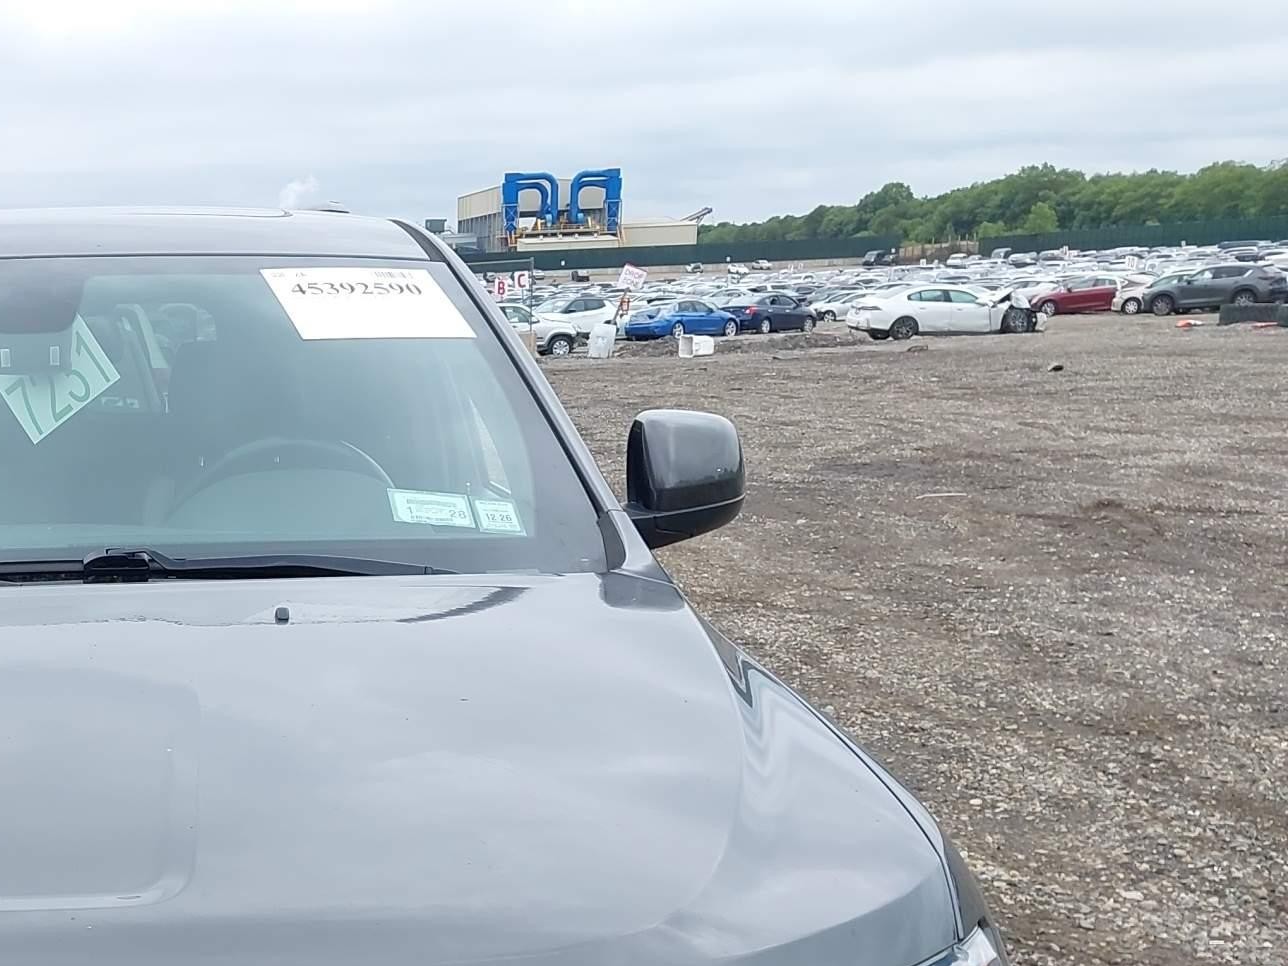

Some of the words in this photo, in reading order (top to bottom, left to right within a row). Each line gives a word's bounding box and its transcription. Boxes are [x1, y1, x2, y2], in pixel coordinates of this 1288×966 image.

[290, 281, 422, 294] 45392590
[517, 273, 526, 288] C
[497, 281, 505, 295] B
